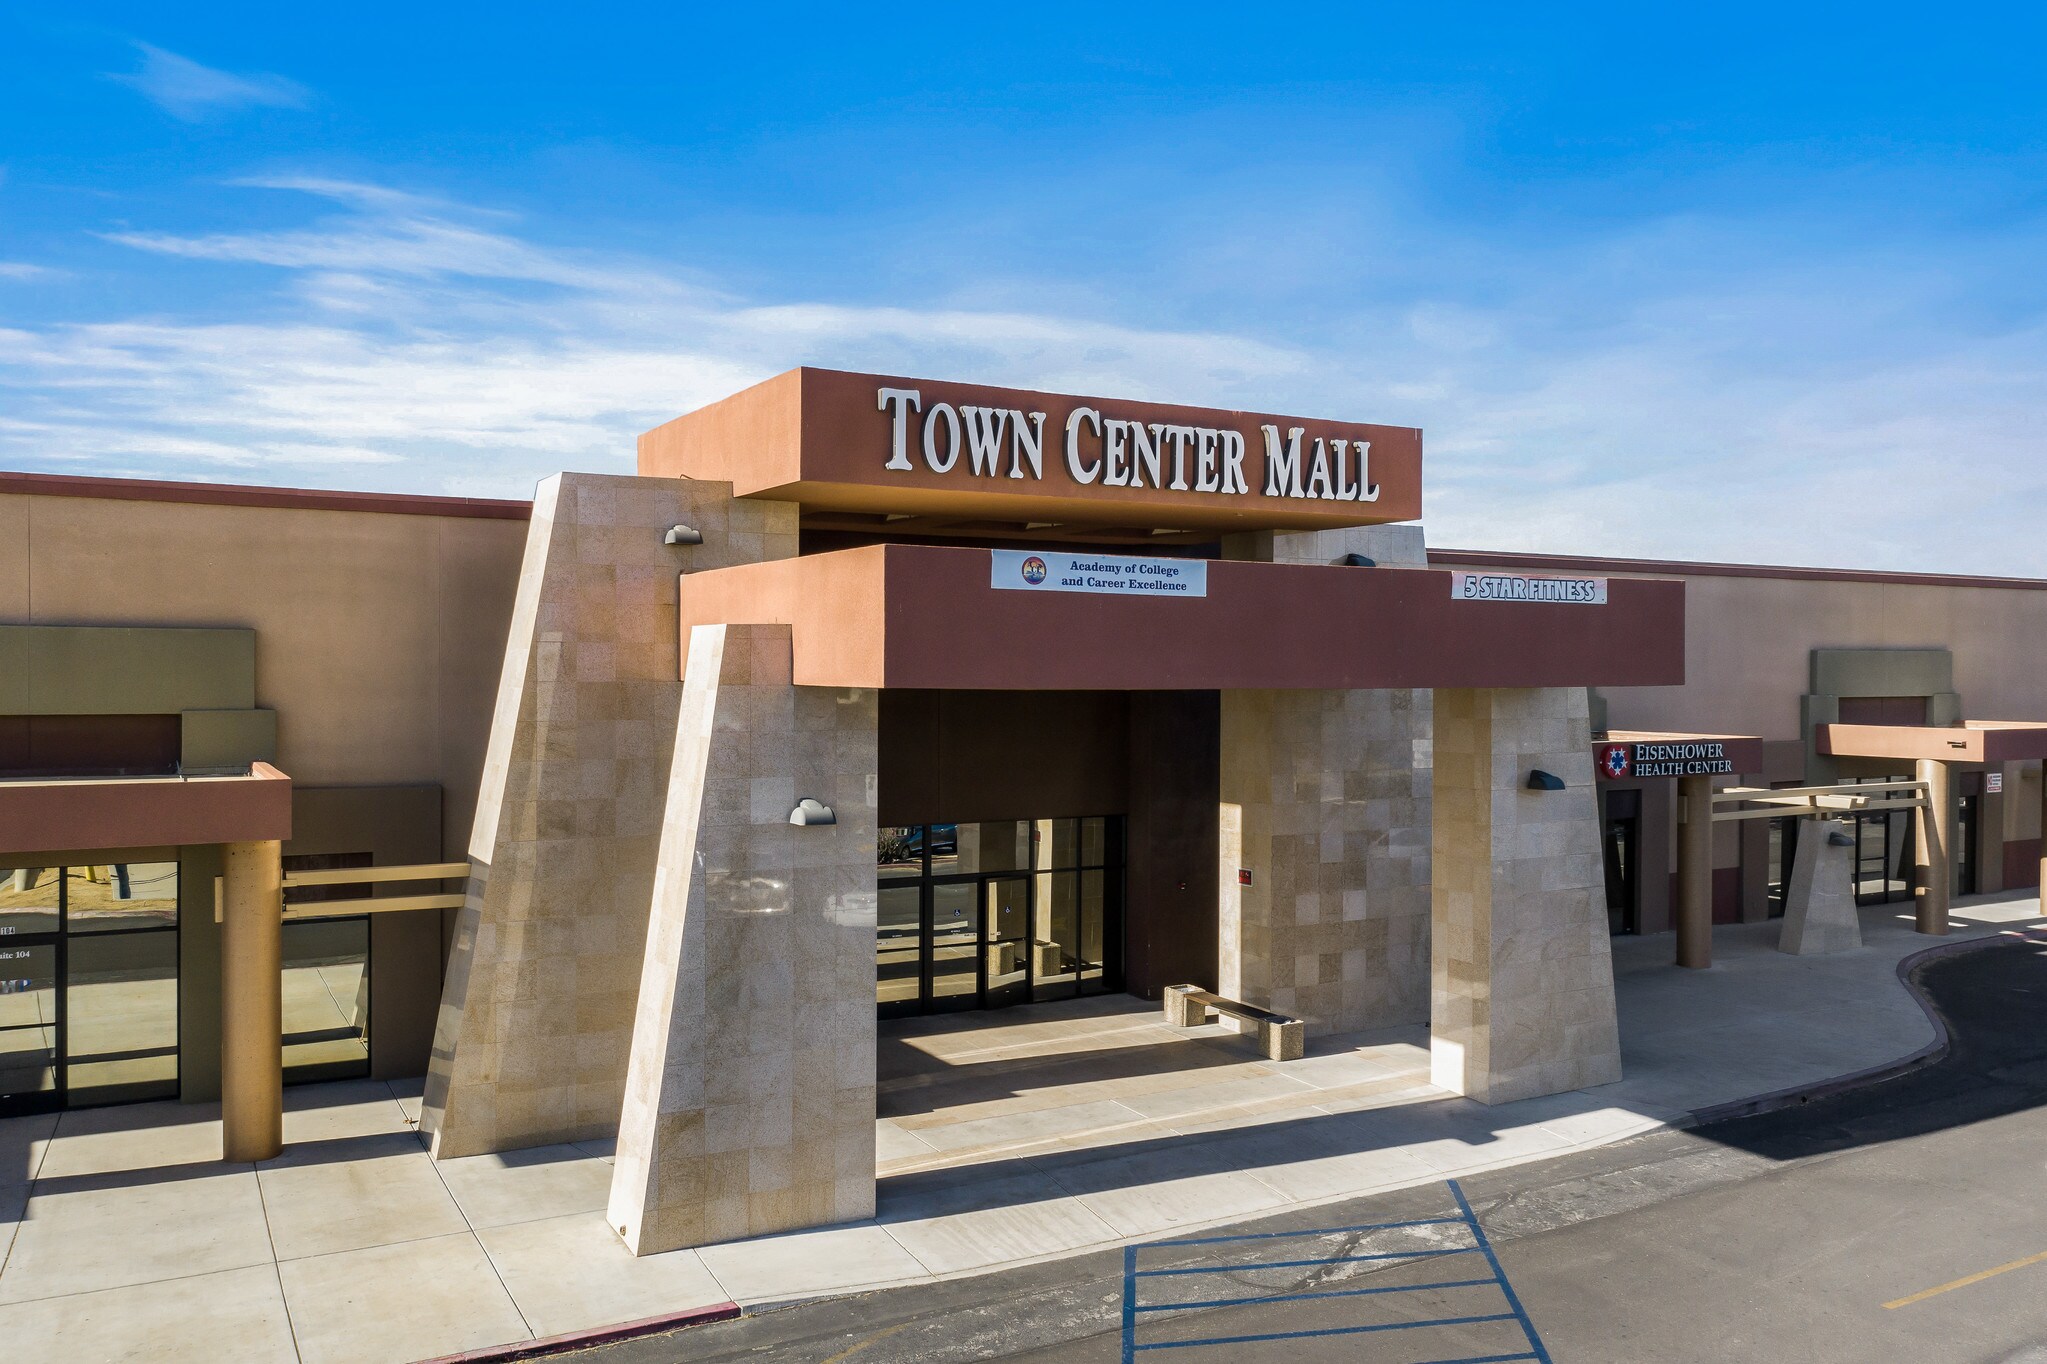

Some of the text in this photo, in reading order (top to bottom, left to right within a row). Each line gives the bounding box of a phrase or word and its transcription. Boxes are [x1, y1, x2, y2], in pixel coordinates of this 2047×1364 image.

[877, 387, 1380, 502] TOWN CENTER MALL
[1070, 561, 1179, 577] Academy of College
[1061, 577, 1187, 591] and Career Excellence
[1464, 575, 1596, 602] 5 STAR FITNESS
[1636, 744, 1723, 761] EISENHOWER
[1635, 760, 1732, 777] HEALTH CENTER
